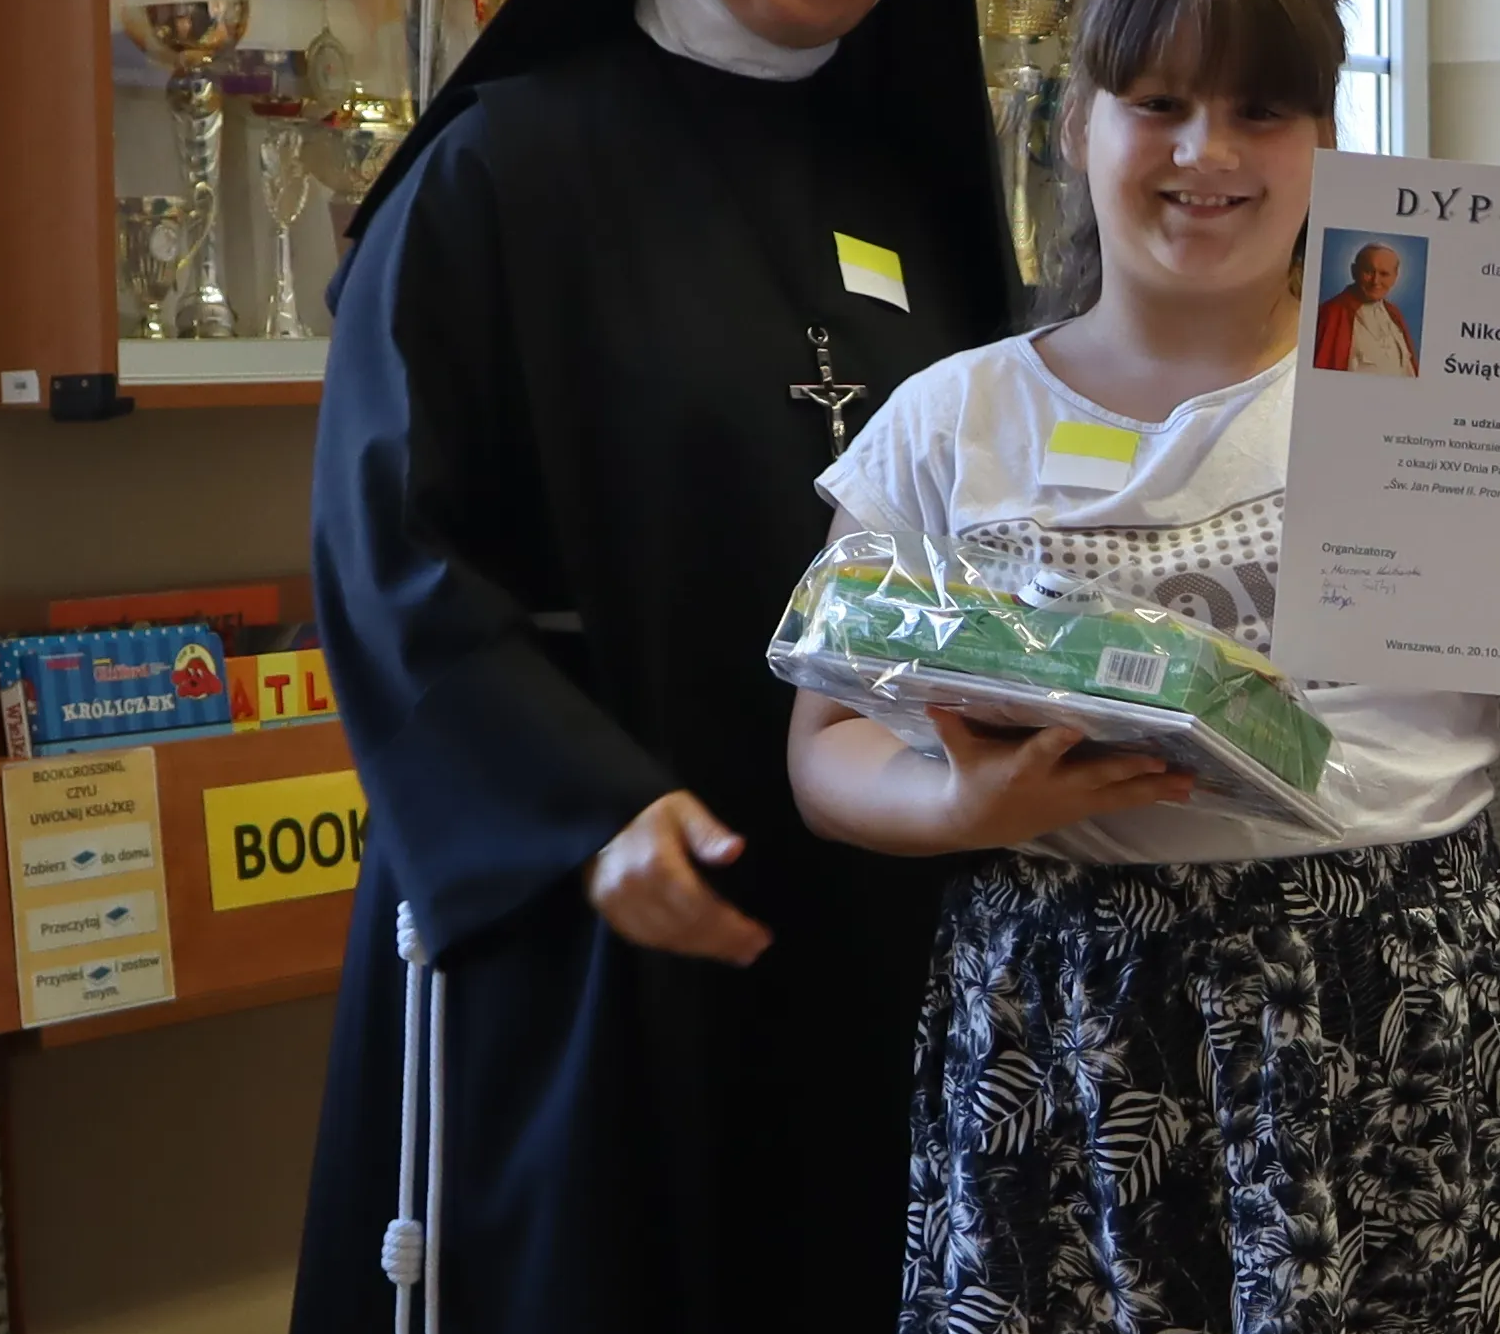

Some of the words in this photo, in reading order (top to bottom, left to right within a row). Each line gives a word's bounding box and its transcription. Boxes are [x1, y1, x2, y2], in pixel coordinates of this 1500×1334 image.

[1453, 418, 1466, 427] za
[1383, 435, 1393, 443] w
[1395, 434, 1446, 450] szkolnym
[1448, 438, 1500, 452] konkursie
[1397, 459, 1403, 467] z
[1405, 458, 1438, 471] okazji
[1439, 460, 1461, 471] XXV
[1463, 463, 1488, 475] Dnia
[1410, 481, 1430, 493] Jan
[1431, 482, 1465, 495] Paweł
[1321, 542, 1397, 560] Organizatorzy
[1385, 639, 1445, 655] Warszawa,
[1447, 644, 1464, 656] dn.
[62, 693, 176, 722] KRÓLICZEK
[66, 785, 98, 800] CZYLI
[30, 809, 83, 825] UWOLNIJ
[23, 860, 67, 877] Zabierz
[101, 852, 116, 865] do
[40, 914, 101, 936] Przeczytaj
[120, 956, 160, 973] zostaw
